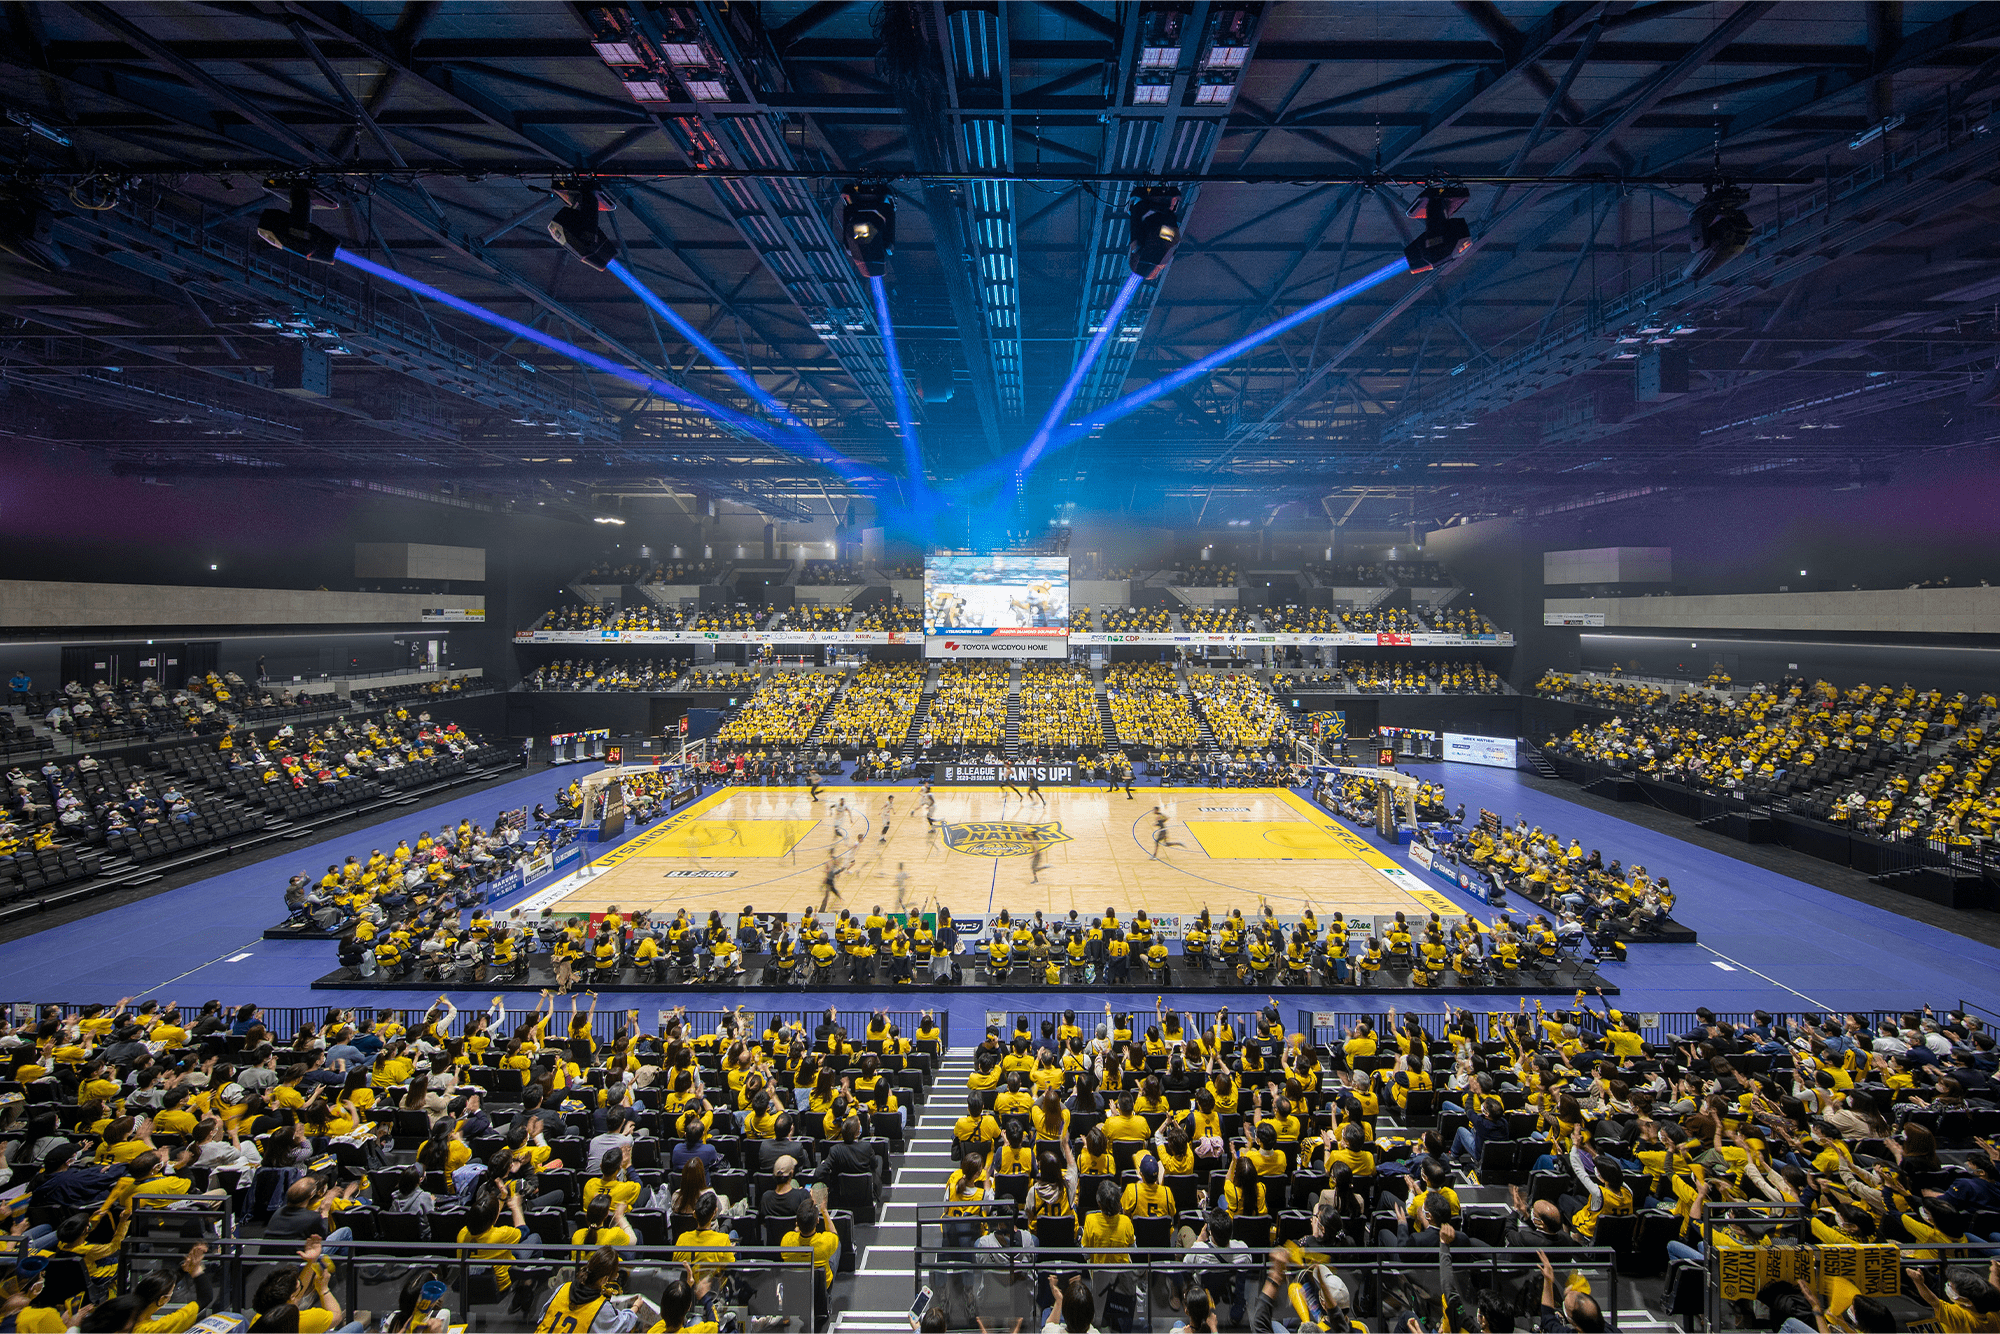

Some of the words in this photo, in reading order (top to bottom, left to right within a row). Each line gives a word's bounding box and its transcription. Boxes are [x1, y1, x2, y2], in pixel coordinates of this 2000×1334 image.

[608, 752, 620, 761] 24
[1381, 754, 1392, 763] 24
[956, 767, 995, 775] B.LEAGUE
[998, 767, 1047, 782] HANDS
[1049, 767, 1072, 782] UP!
[966, 823, 1056, 833] BREX
[596, 813, 693, 866] UTSUNOMIYA
[968, 832, 1062, 841] NATION
[1324, 825, 1376, 855] BREX
[492, 873, 518, 889] MARUWA
[666, 870, 734, 878] B.LEAGUE
[1347, 918, 1371, 930] Tree
[1723, 1250, 1739, 1283] ANZAI
[1840, 1247, 1857, 1276] RYAN
[1739, 1250, 1756, 1294] RYUZO
[1864, 1247, 1880, 1295] HIEJIMA
[1880, 1247, 1897, 1294] MAKOTO
